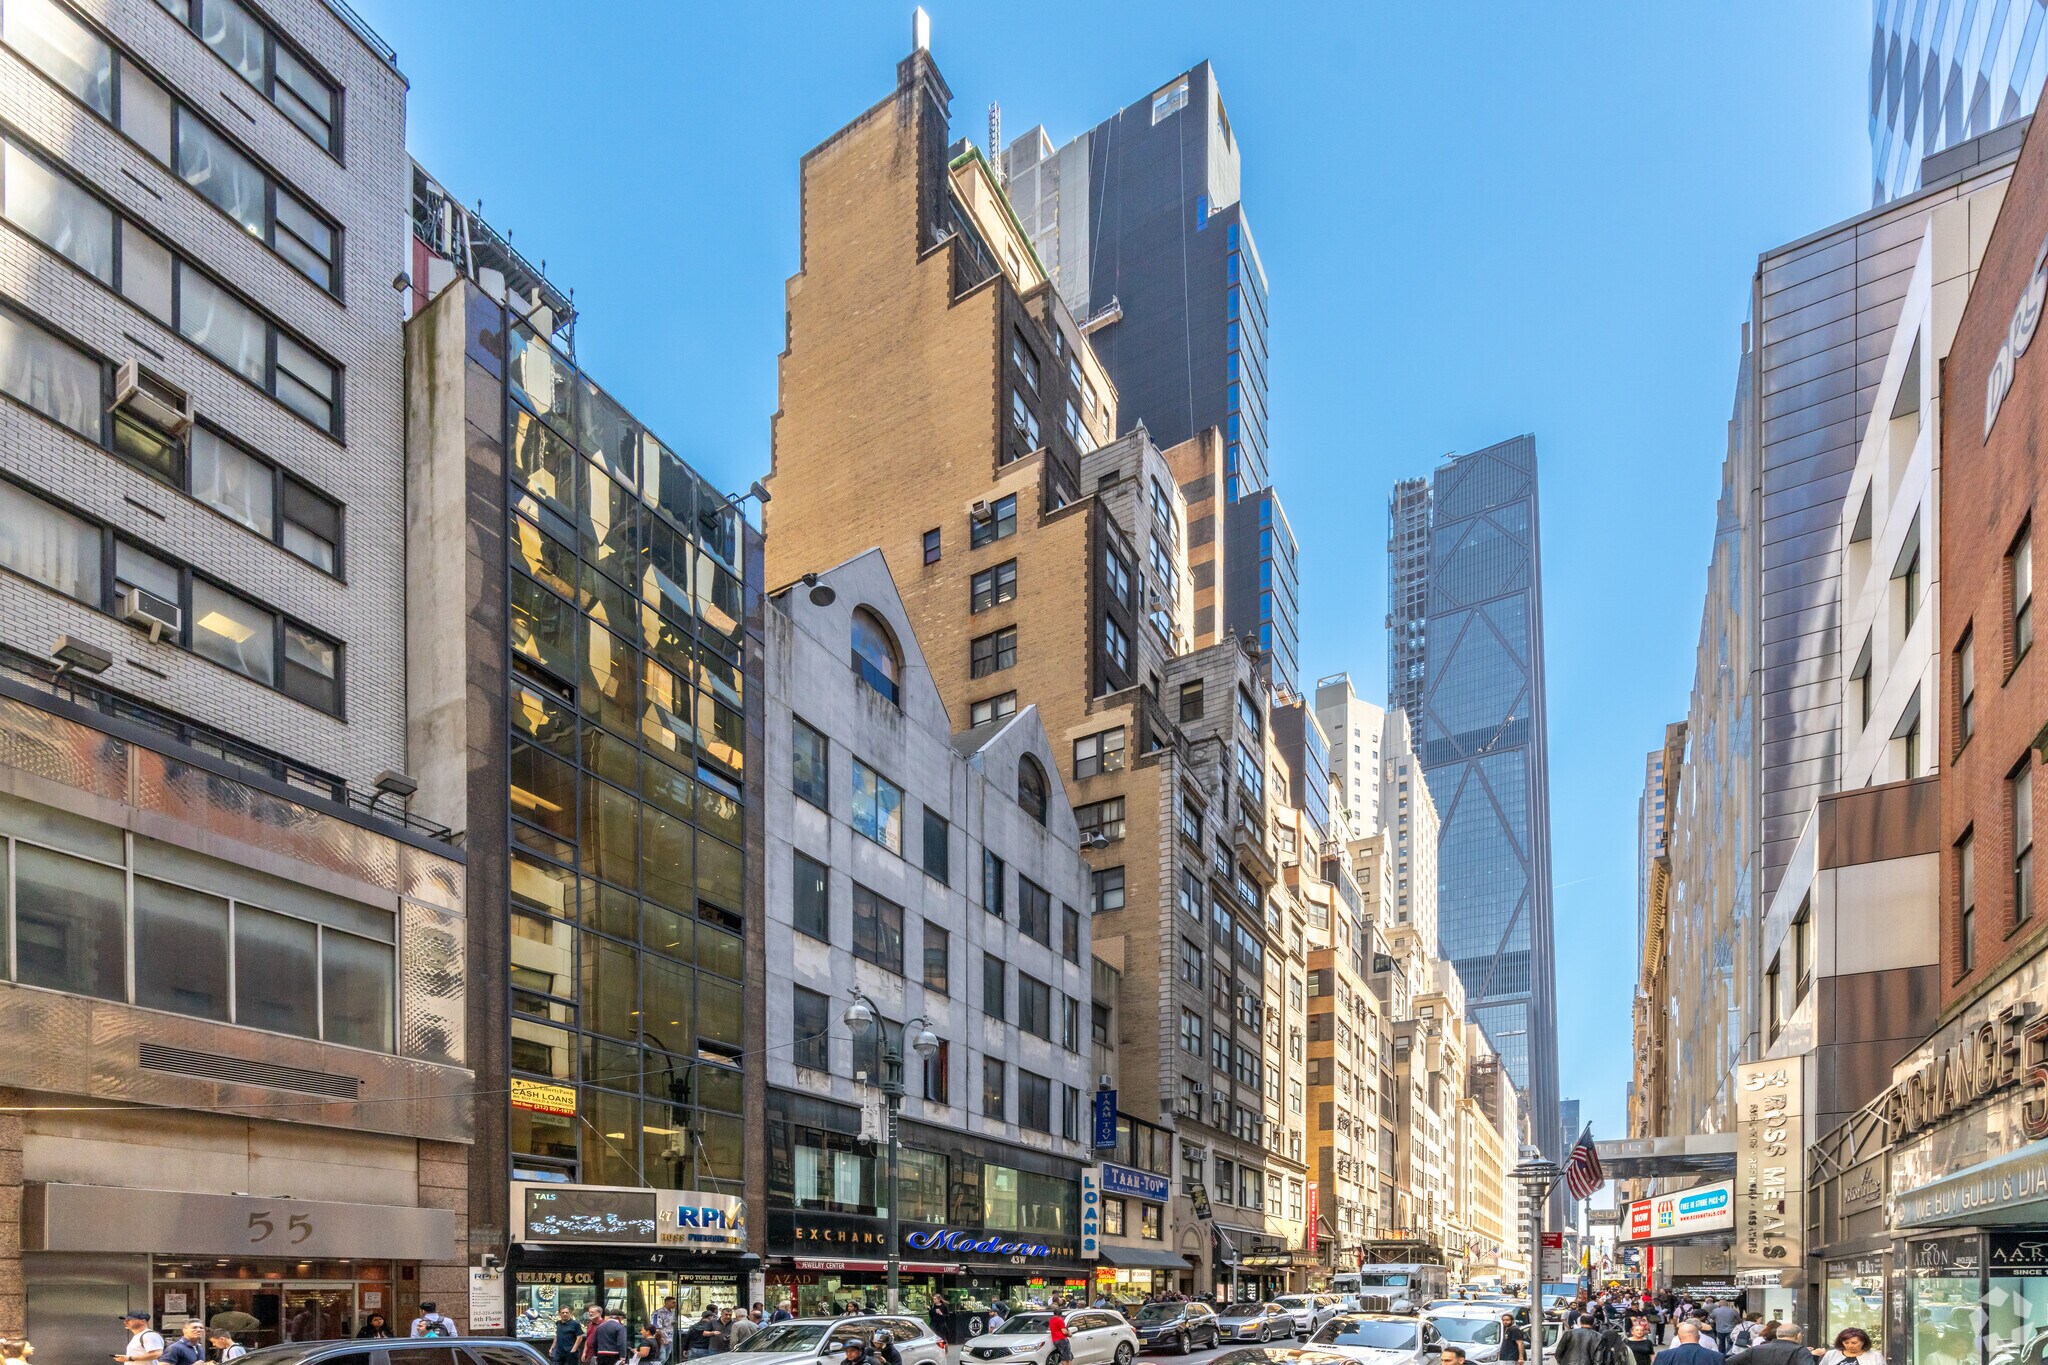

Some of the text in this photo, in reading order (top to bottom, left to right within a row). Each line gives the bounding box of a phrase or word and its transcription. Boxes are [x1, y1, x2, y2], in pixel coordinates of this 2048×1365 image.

[1889, 1003, 2024, 1144] EXCHANGE
[512, 1088, 574, 1104] CASH LOANS
[1102, 1093, 1112, 1140] TAAM-TOV
[1112, 1167, 1161, 1193] TAAM-TOV
[1762, 1094, 1788, 1260] ROSS METALS
[1680, 1202, 1689, 1210] FREE
[1915, 1198, 1931, 1221] WE
[1935, 1186, 1958, 1214] BUY
[1961, 1178, 1997, 1209] GOLD
[2002, 1174, 2012, 1200] &
[677, 1202, 742, 1230] RPM
[1084, 1176, 1098, 1251] LOANS
[1634, 1212, 1648, 1222] NOW
[1632, 1225, 1650, 1233] OFFERS
[796, 1228, 1074, 1257] EXCHANG Modern PAWN
[650, 1254, 664, 1263] 47
[516, 1272, 594, 1284] NELLY'S & CO.
[772, 1274, 811, 1284] AZAD
